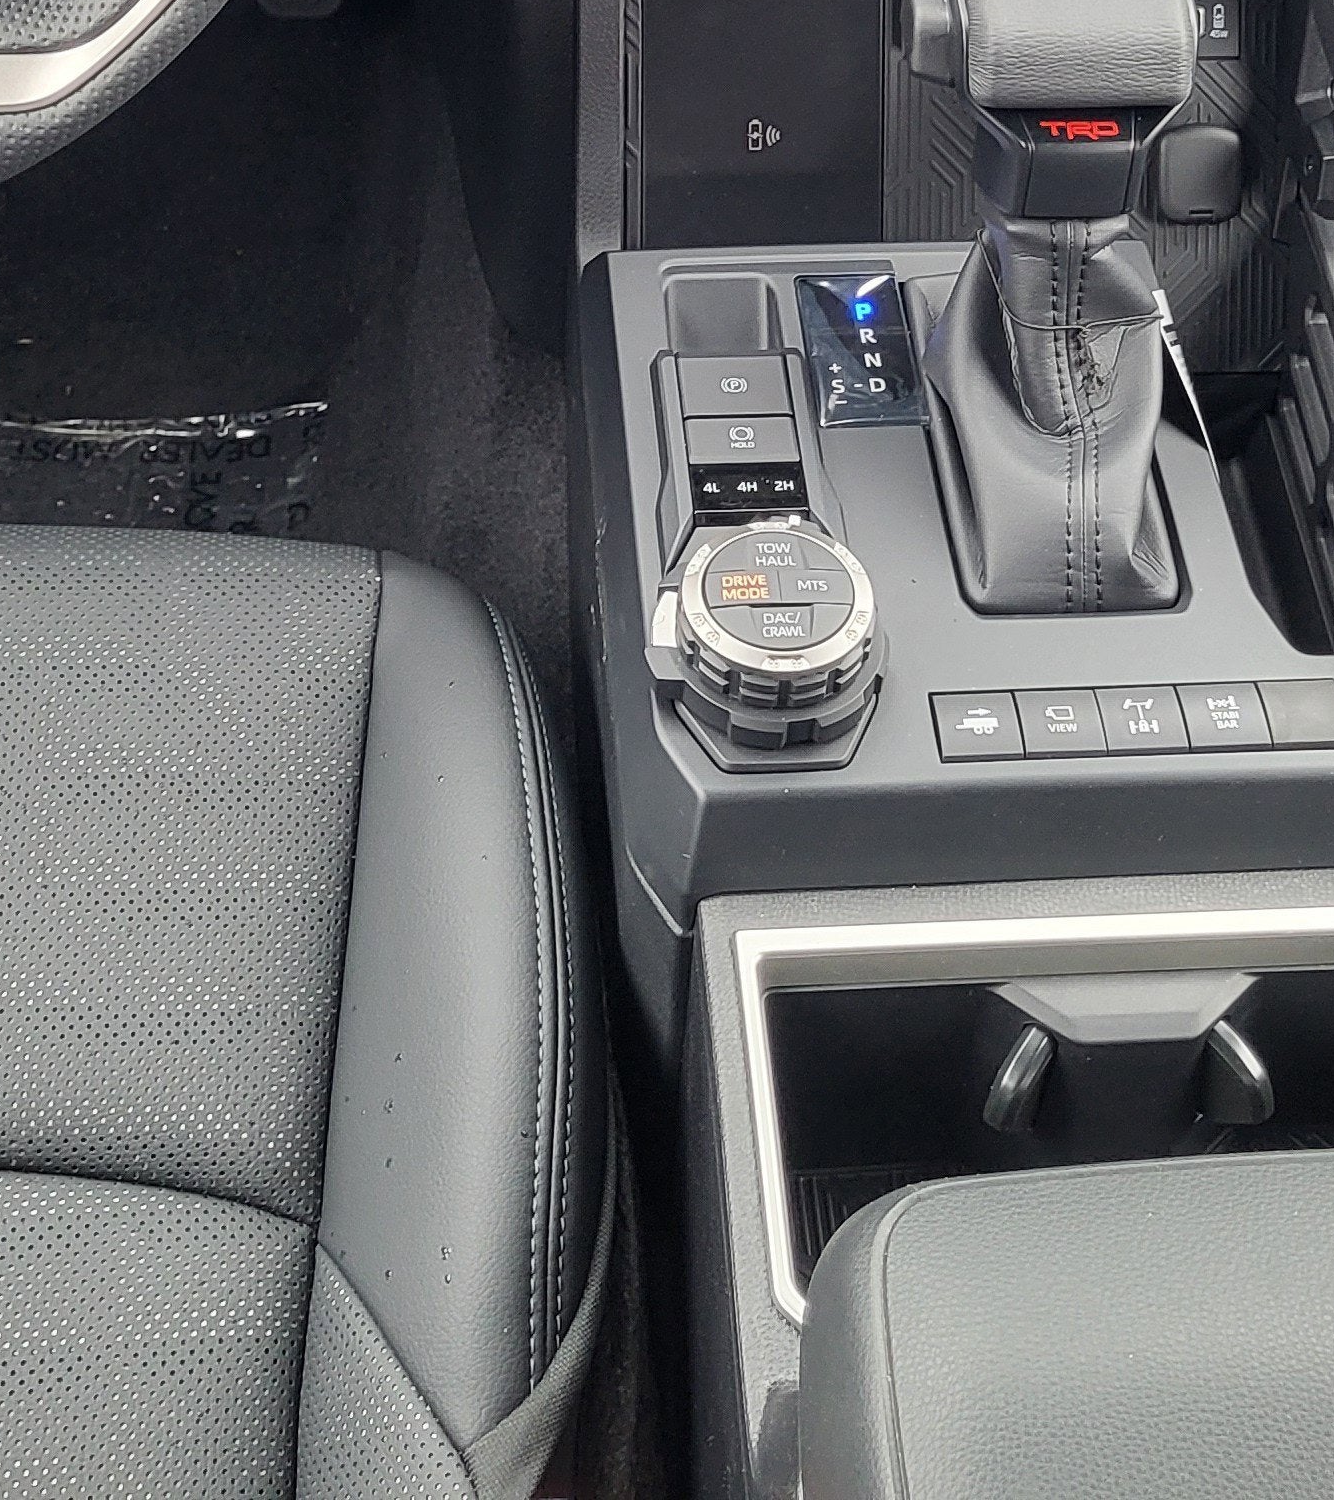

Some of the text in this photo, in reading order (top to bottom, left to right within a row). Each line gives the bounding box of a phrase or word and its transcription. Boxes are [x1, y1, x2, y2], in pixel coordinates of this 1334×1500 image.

[1039, 121, 1120, 140] TRD
[854, 302, 873, 321] P
[859, 328, 877, 344] R
[864, 352, 882, 368] N
[831, 377, 886, 394] S D
[702, 480, 795, 493] 4L 4H 2H
[756, 543, 791, 554] TOW
[755, 555, 797, 567] HAUL
[721, 574, 768, 588] DRIVE
[797, 579, 828, 591] MTS
[722, 587, 771, 601] MODE
[763, 612, 801, 624] DAC/
[762, 626, 806, 638] CRAWL
[1211, 711, 1240, 721] STABI
[1047, 723, 1078, 734] VIEW
[1216, 720, 1239, 730] BAR
